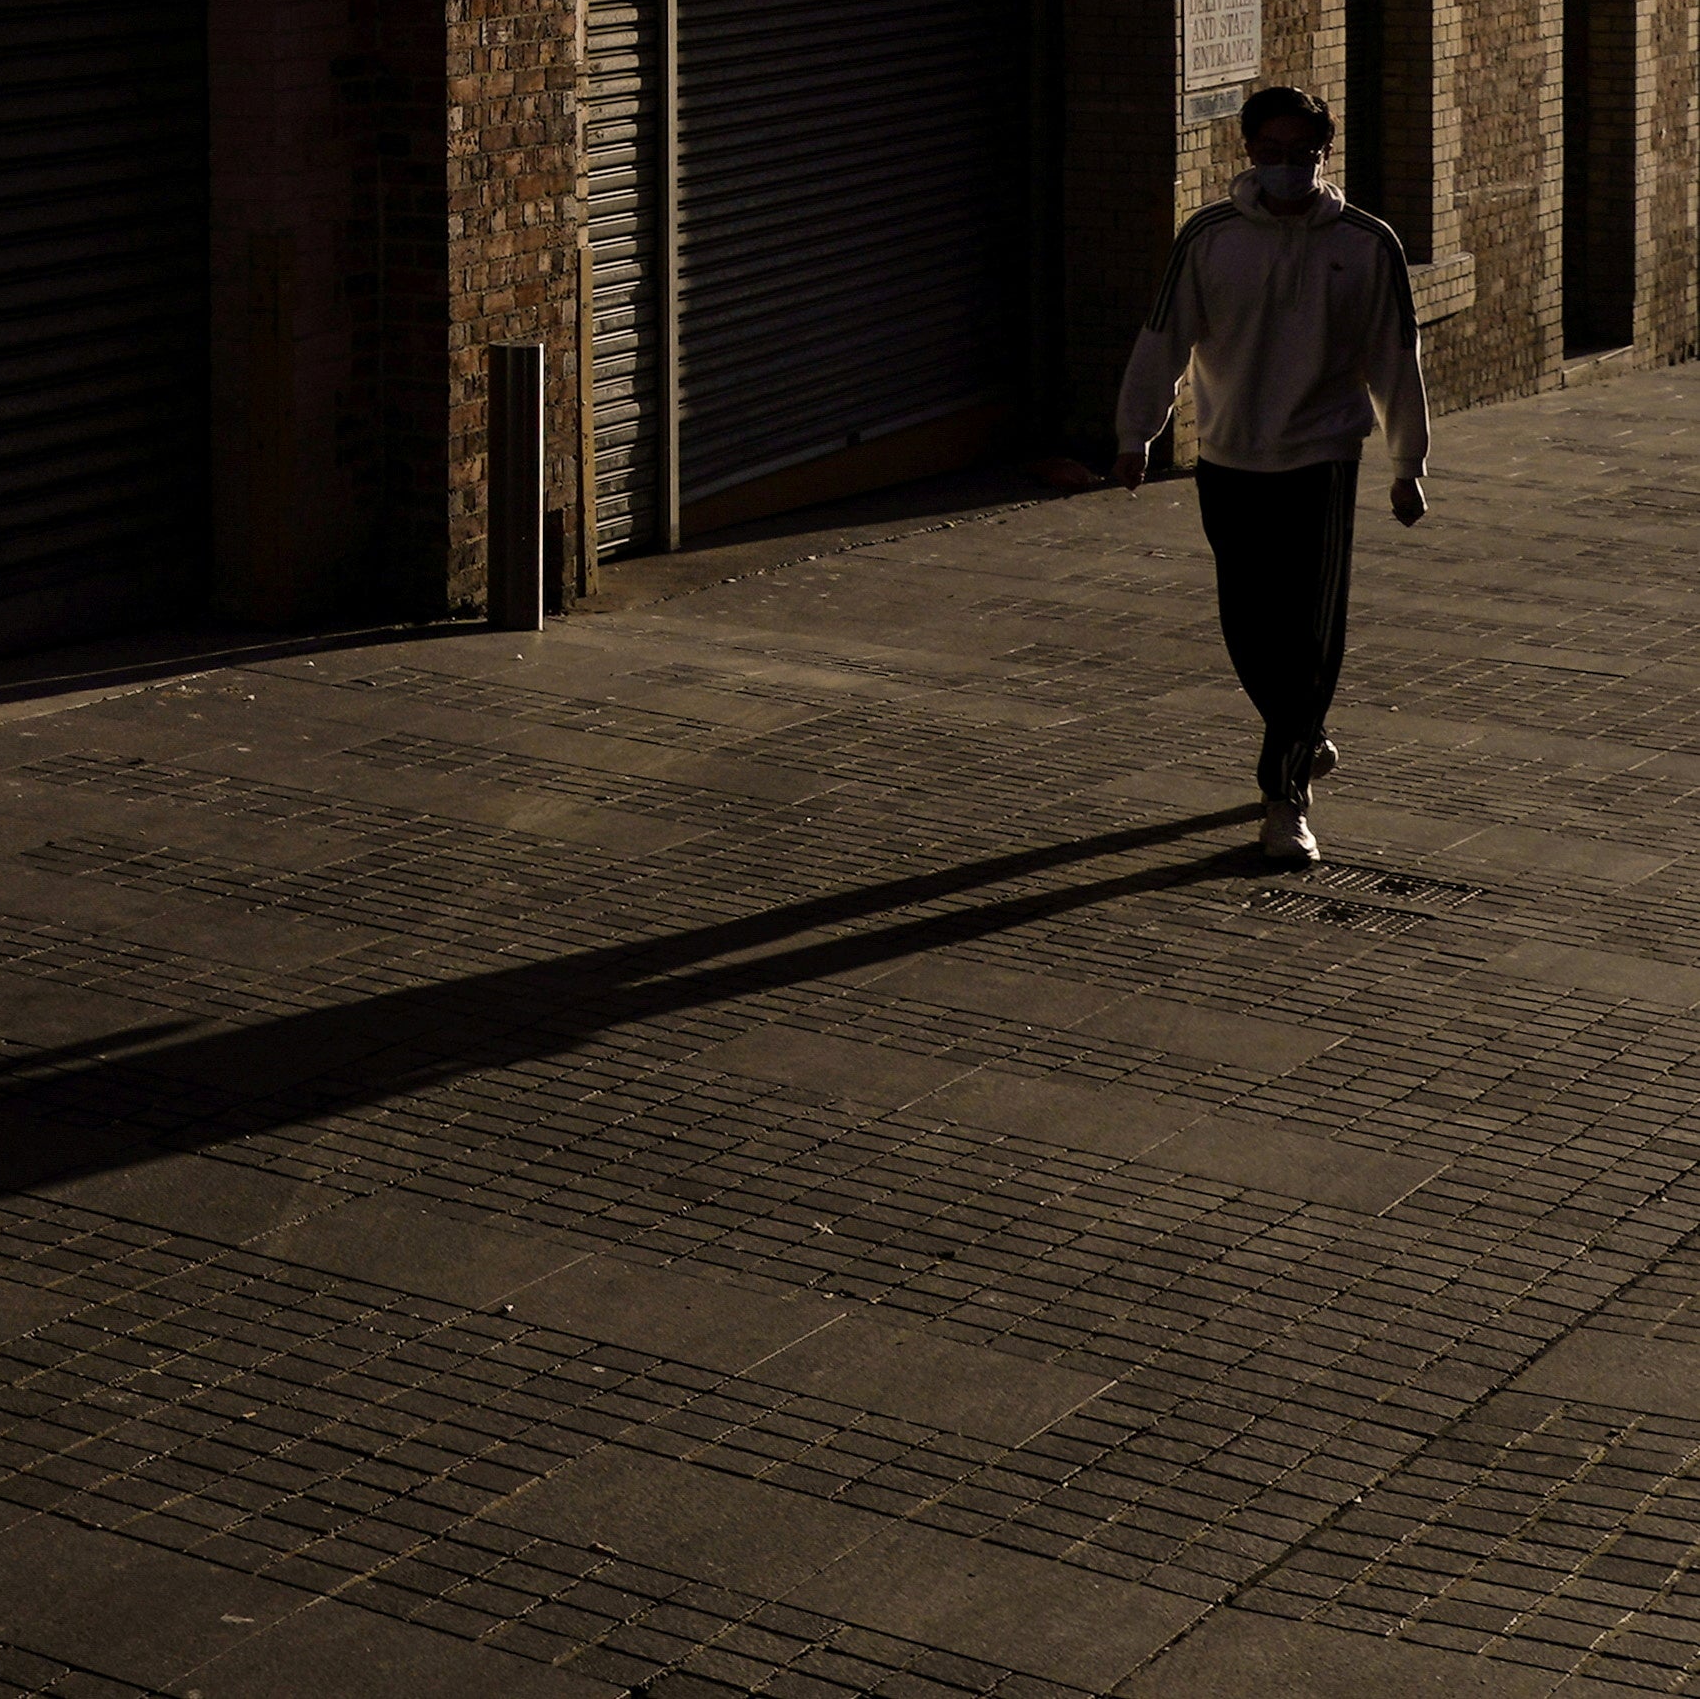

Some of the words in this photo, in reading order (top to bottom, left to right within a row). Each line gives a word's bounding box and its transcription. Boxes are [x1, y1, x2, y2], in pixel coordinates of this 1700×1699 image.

[1192, 17, 1217, 43] AND
[1219, 10, 1254, 38] STAFF
[1193, 38, 1254, 71] ENTRANCE
